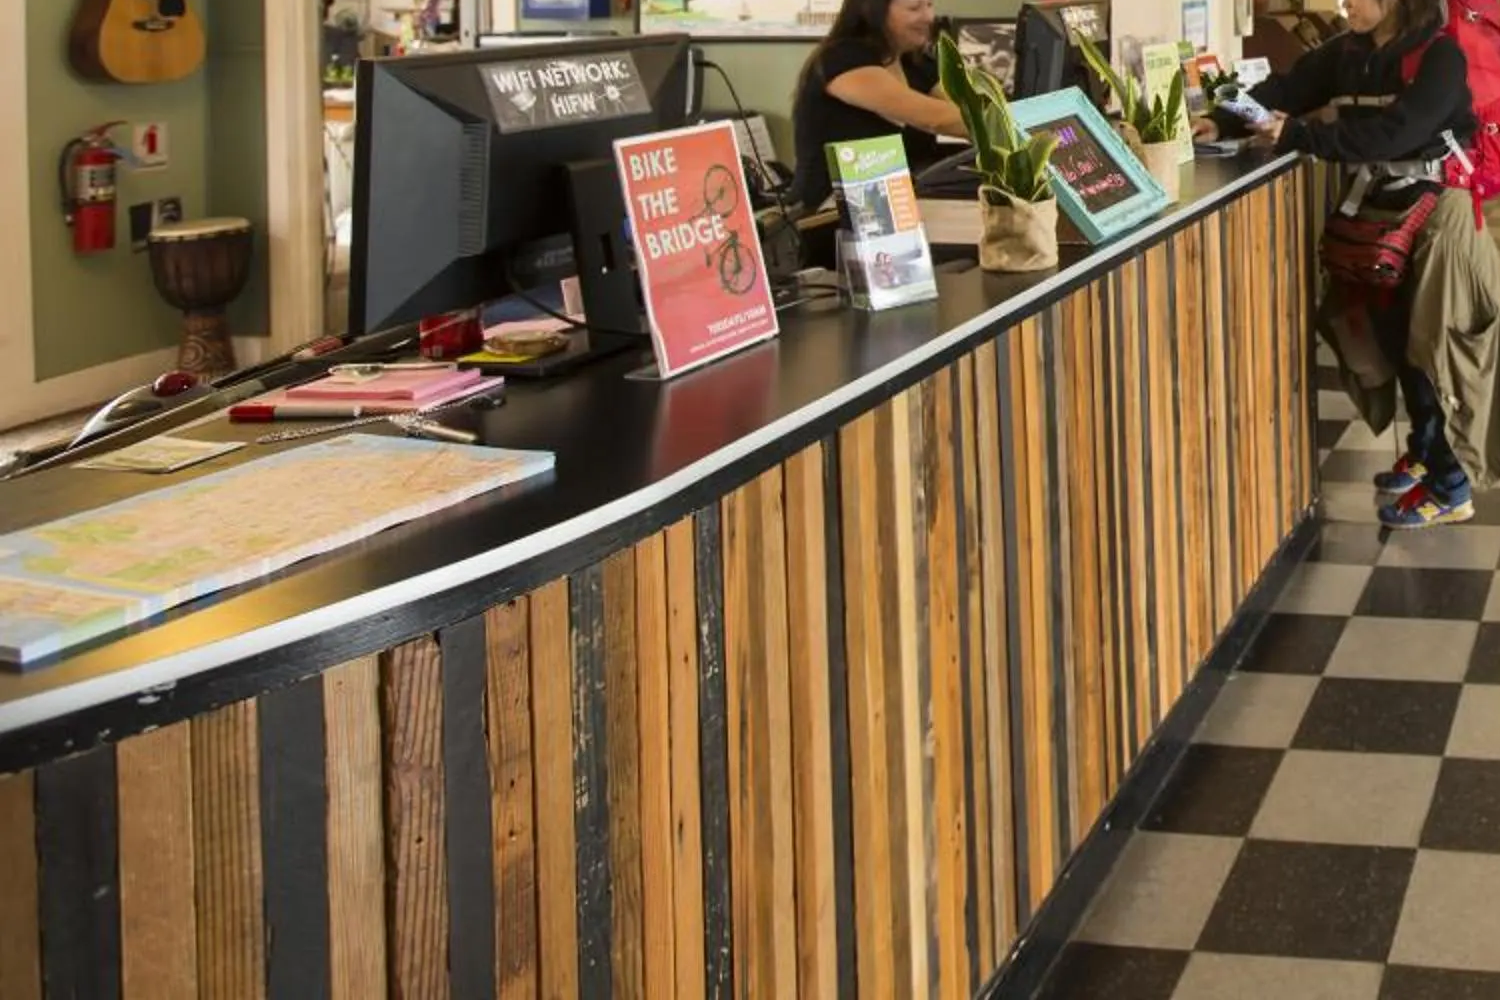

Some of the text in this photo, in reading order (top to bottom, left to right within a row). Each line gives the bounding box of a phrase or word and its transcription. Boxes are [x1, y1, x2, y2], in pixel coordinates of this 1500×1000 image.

[492, 60, 632, 93] WIFI NETWORK:
[628, 147, 679, 182] BIKE
[637, 187, 681, 222] THE
[644, 214, 728, 260] BRIDGE
